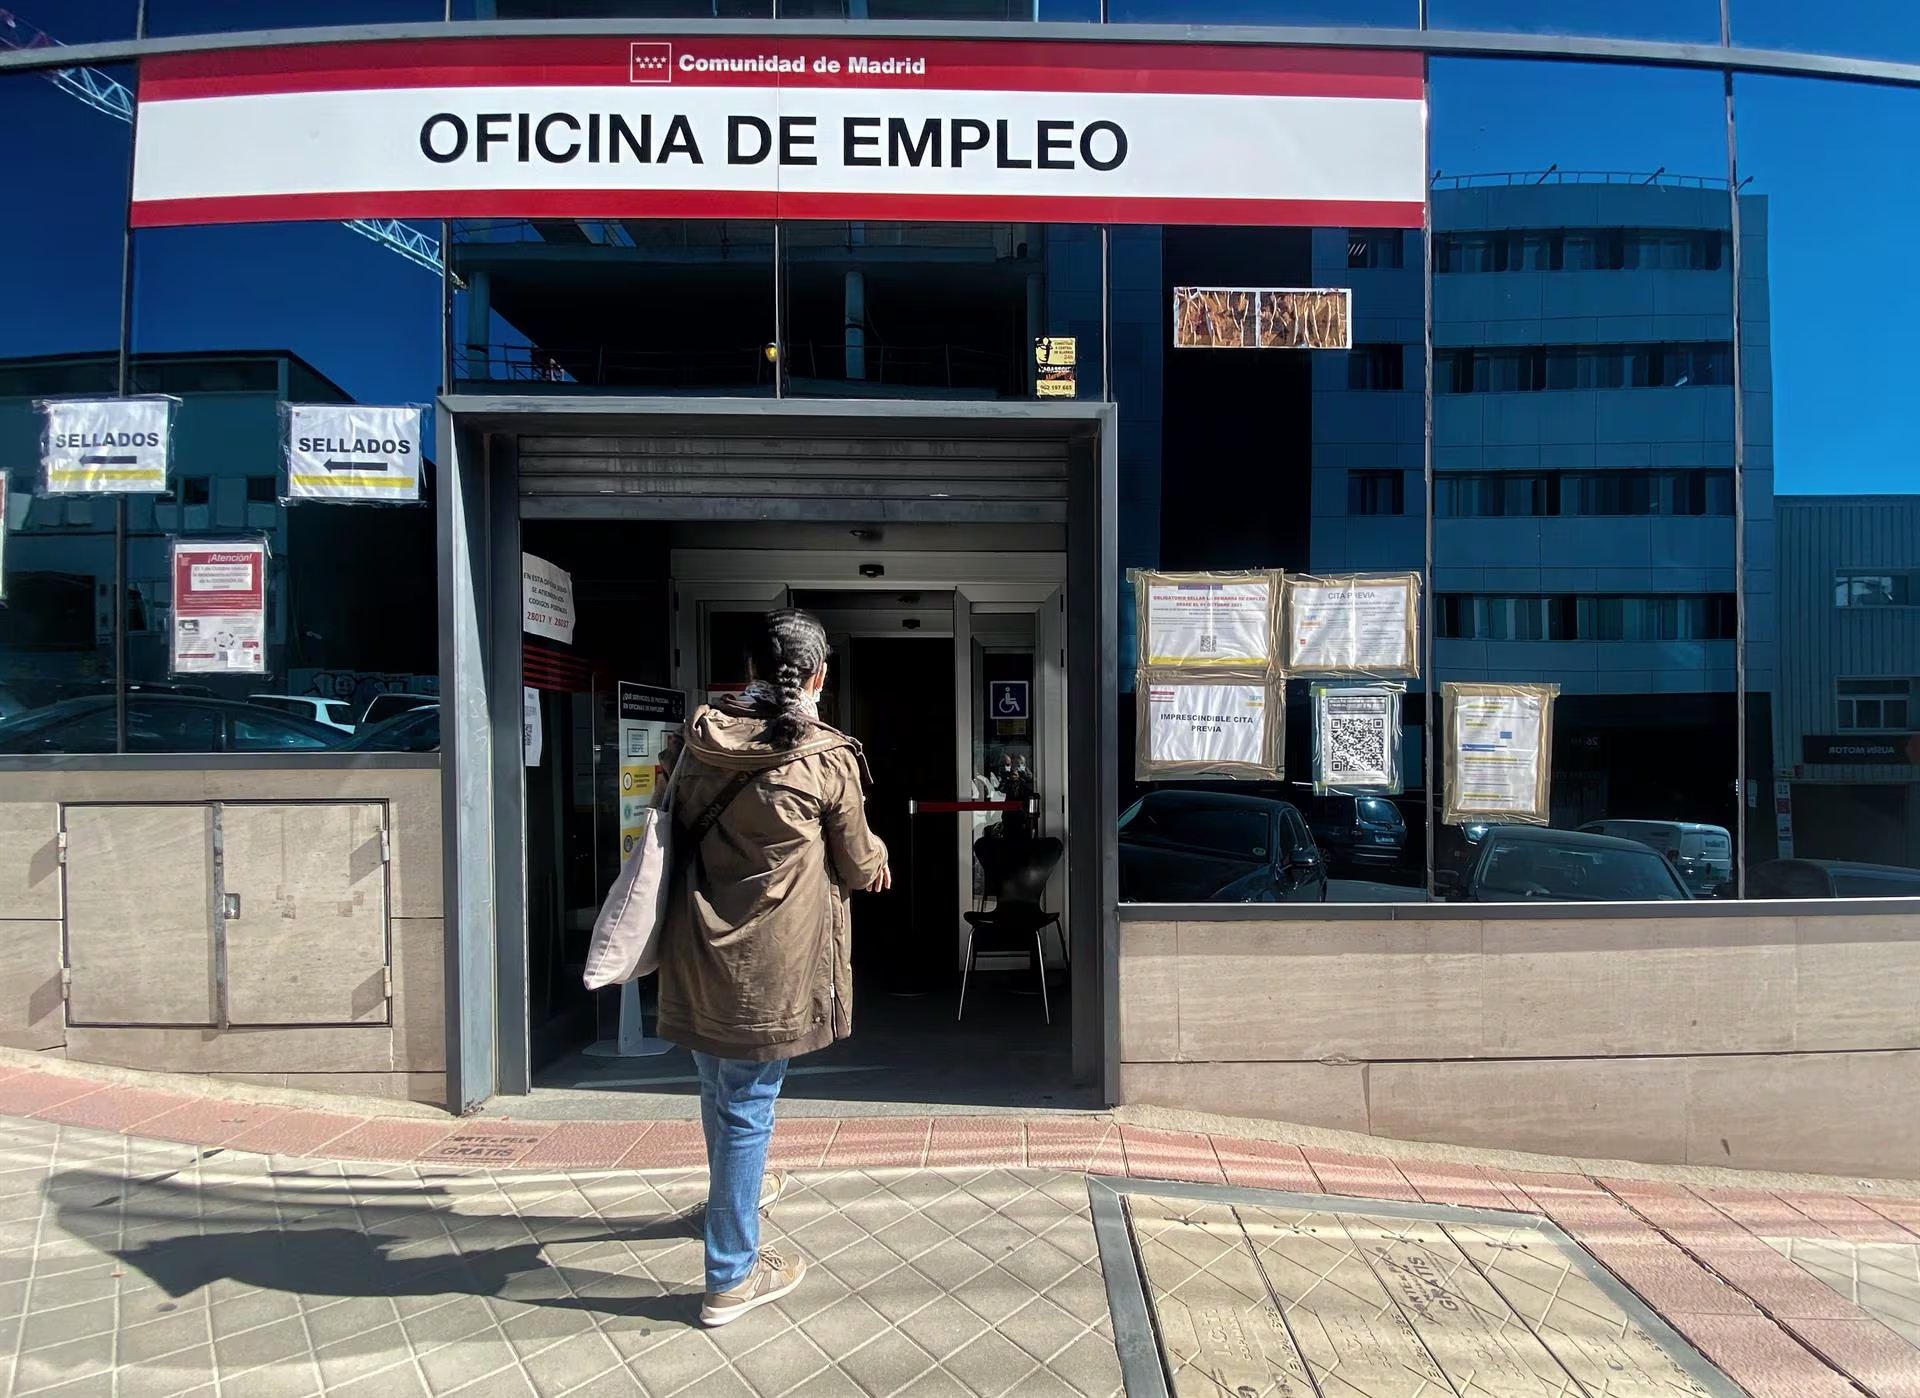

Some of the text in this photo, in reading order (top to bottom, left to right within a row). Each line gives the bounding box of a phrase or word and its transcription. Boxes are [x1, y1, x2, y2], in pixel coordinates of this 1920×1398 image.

[679, 54, 925, 75] Comunidad de Madrid
[419, 112, 1129, 171] OFICINA DE EMPLEO
[55, 432, 159, 448] SELLADOS
[298, 437, 411, 454] SELLADOS
[208, 553, 252, 563] ¡Atención!
[1327, 592, 1346, 600] CITA
[1160, 713, 1231, 723] IMPRESCINDIBLE
[441, 1147, 514, 1157] GRATIS
[1407, 1256, 1461, 1312] GRATIS
